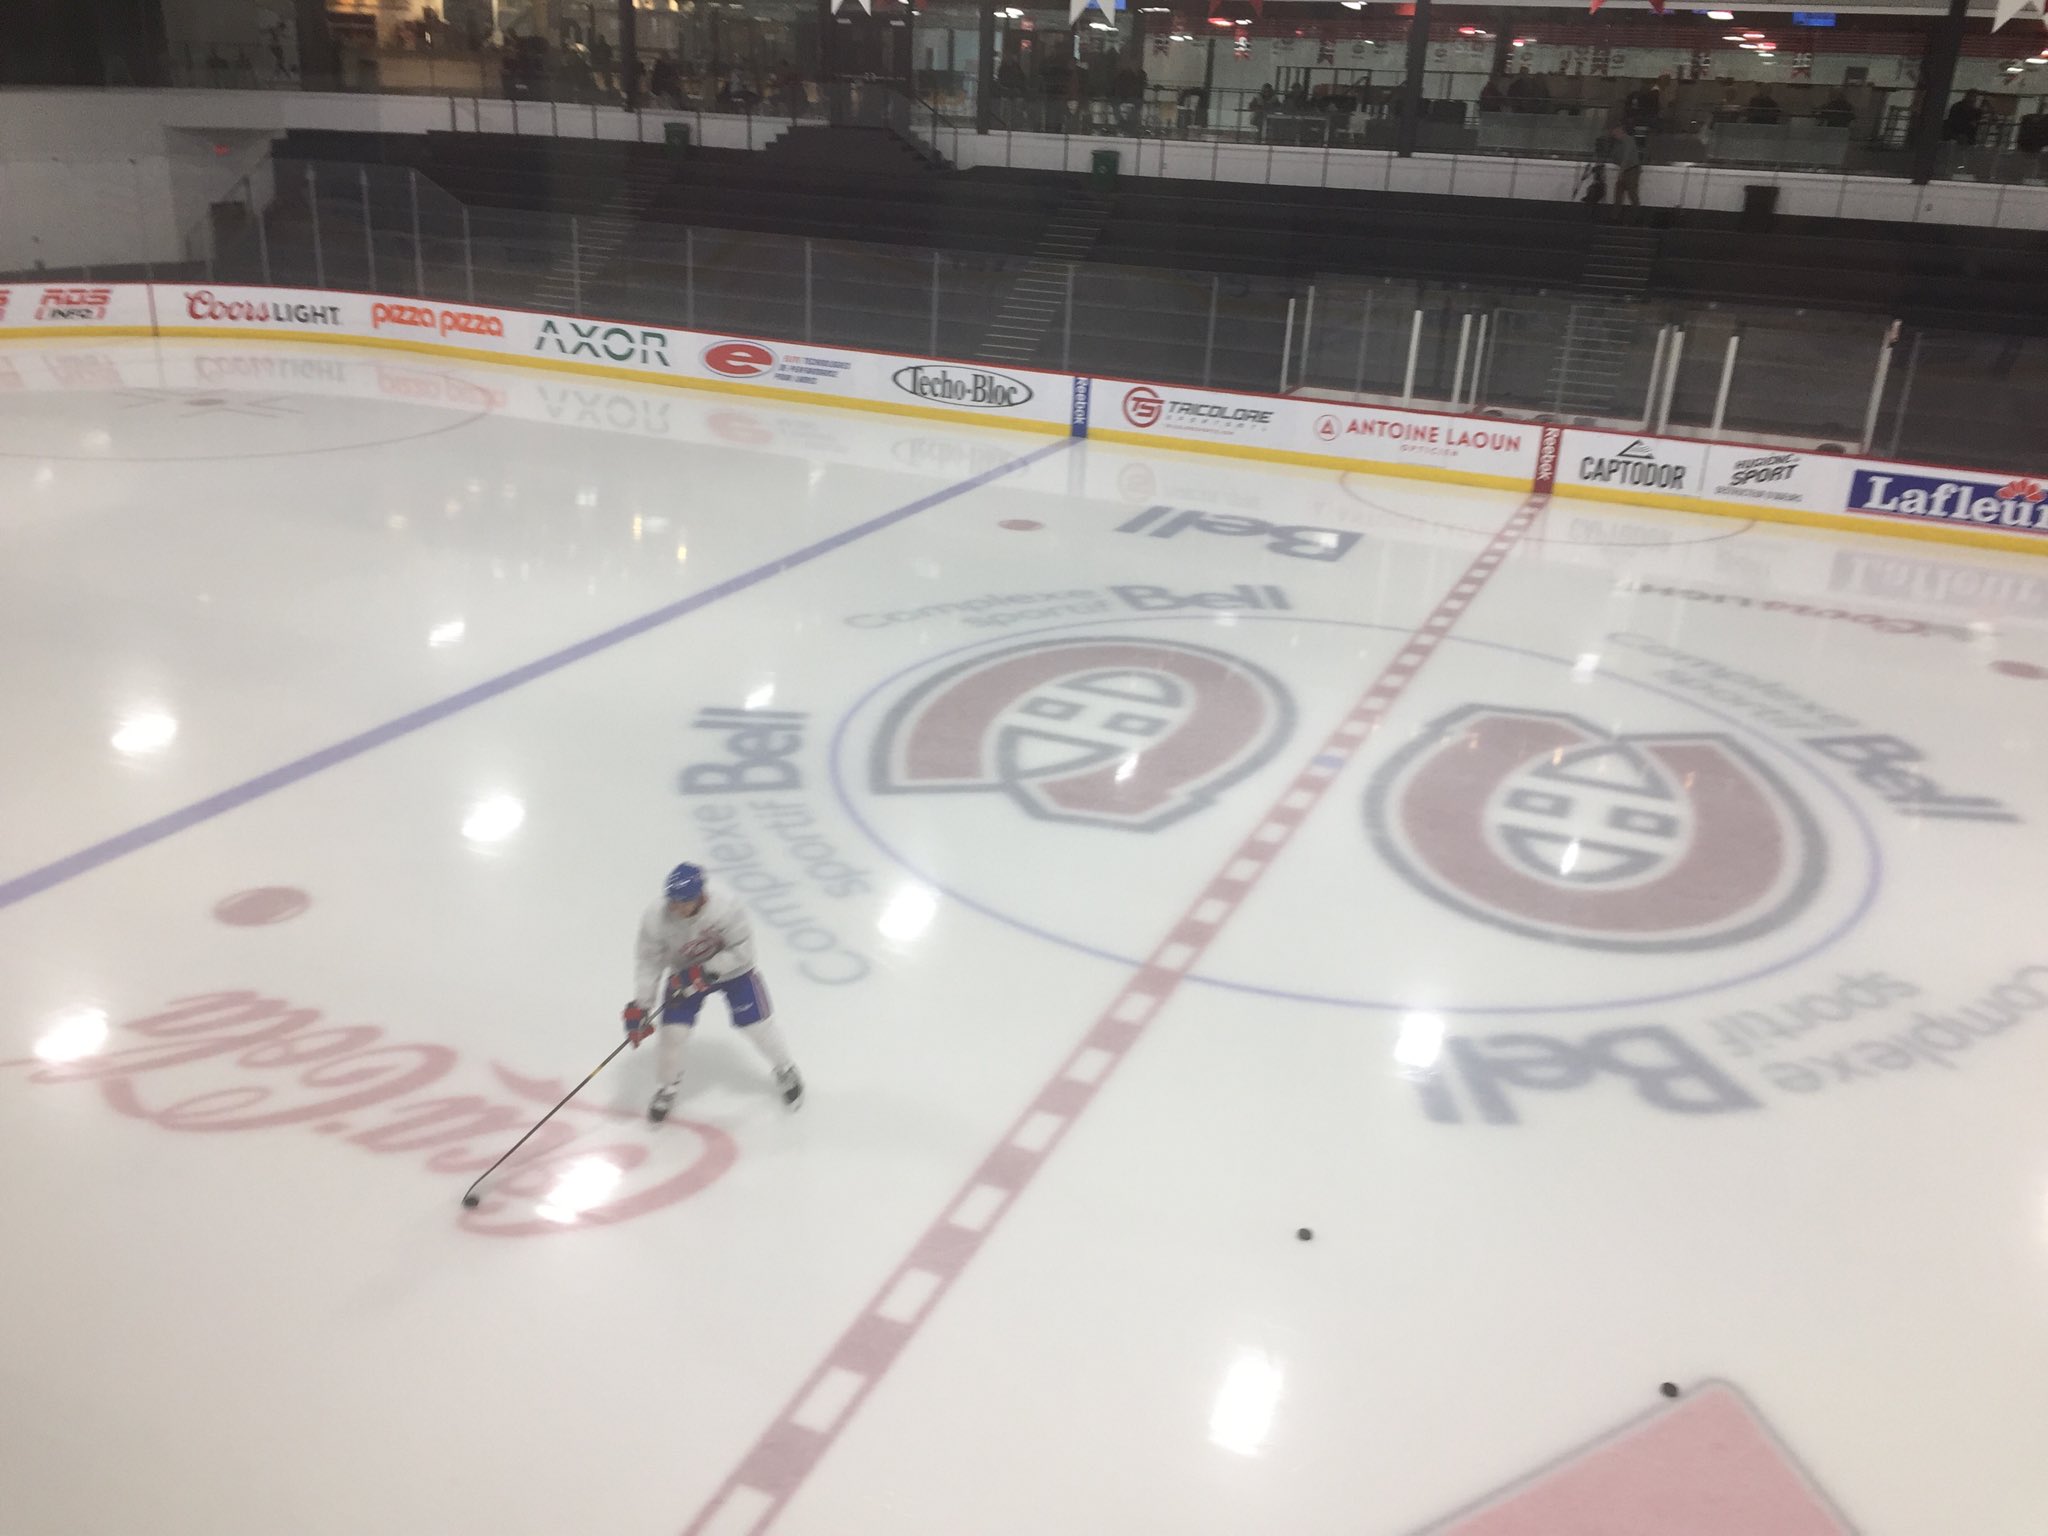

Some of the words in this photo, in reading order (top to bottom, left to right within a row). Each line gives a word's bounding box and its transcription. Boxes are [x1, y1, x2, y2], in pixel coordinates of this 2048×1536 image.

[272, 302, 341, 325] LIGHT
[371, 302, 435, 328] pizza
[440, 310, 504, 337] pizza
[535, 319, 670, 368] AXOR
[909, 366, 1018, 406] Techo-Bloc
[1073, 378, 1088, 424] Reebok
[1167, 401, 1274, 424] TRICOLORE
[1346, 418, 1440, 443] ANTOINE
[1446, 428, 1521, 452] LAOUN
[1536, 428, 1560, 480] Reebok
[1579, 456, 1686, 489] CAPTODOR
[1729, 464, 1799, 486] SPORT
[1115, 507, 1364, 562] Bell
[1107, 584, 1292, 611] Bell
[675, 707, 811, 796] Bell
[1801, 733, 2026, 825] Bell
[1412, 1024, 1765, 1125] Bell
